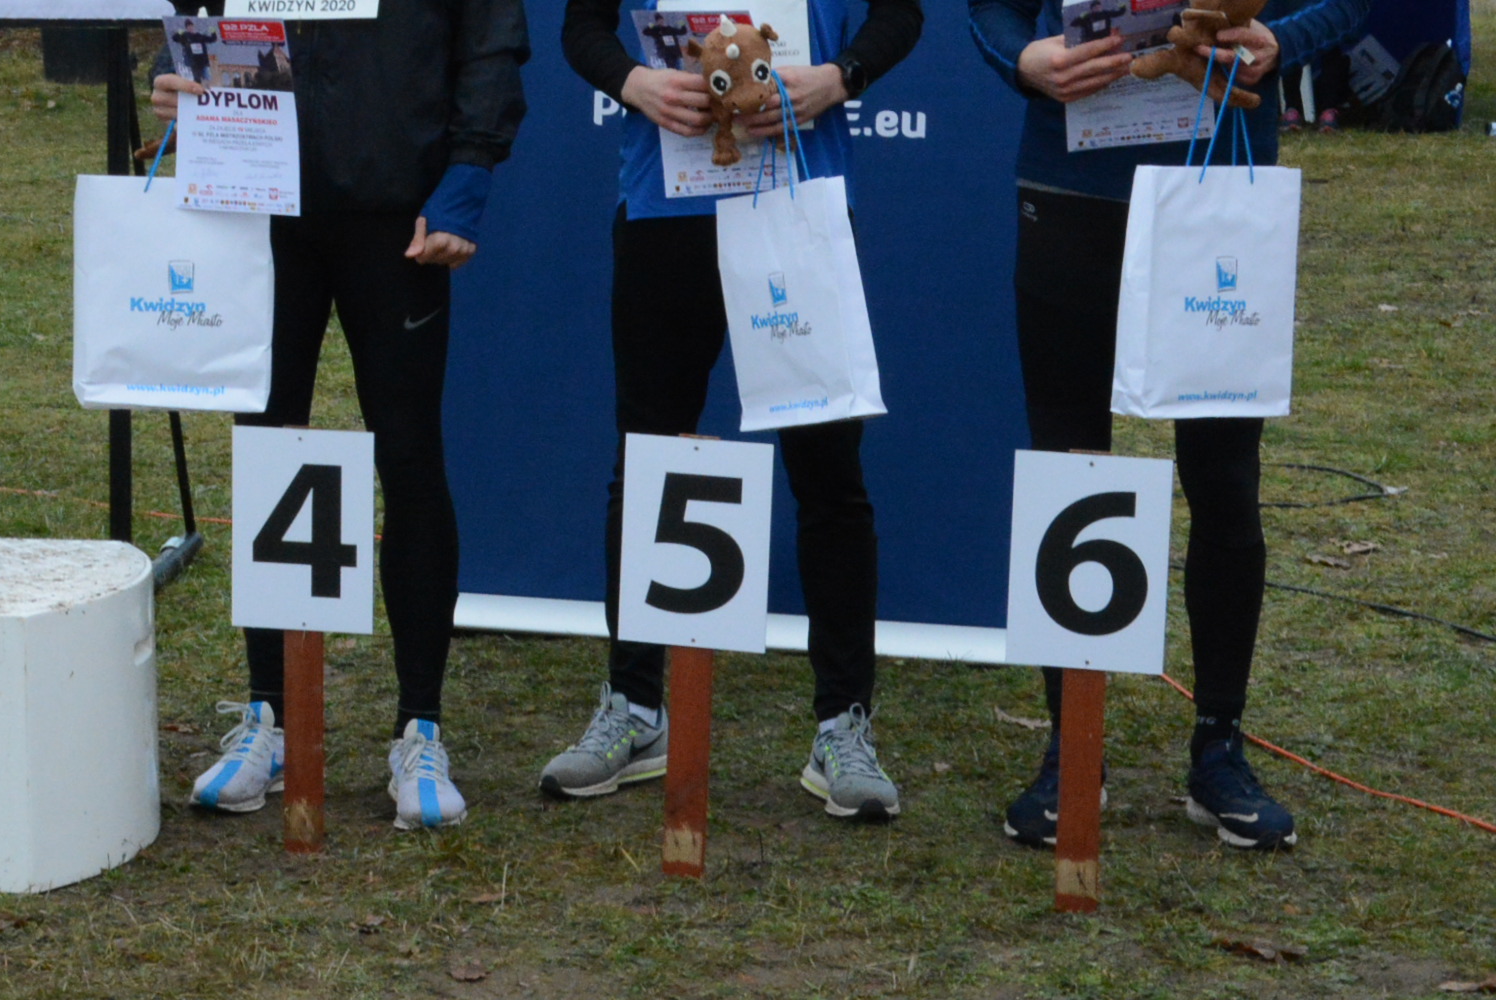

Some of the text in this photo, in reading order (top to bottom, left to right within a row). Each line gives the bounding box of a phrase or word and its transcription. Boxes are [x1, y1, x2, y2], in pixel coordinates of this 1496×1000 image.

[247, 0, 356, 13] KWIDZYN 2020
[197, 90, 279, 111] DYPLOM
[130, 296, 207, 317] Kwidzyn
[1184, 295, 1247, 316] Kwidzyn
[750, 310, 799, 331] Kwidzyn
[252, 463, 358, 600] 4
[644, 471, 745, 615] 5
[1034, 490, 1149, 637] 6
